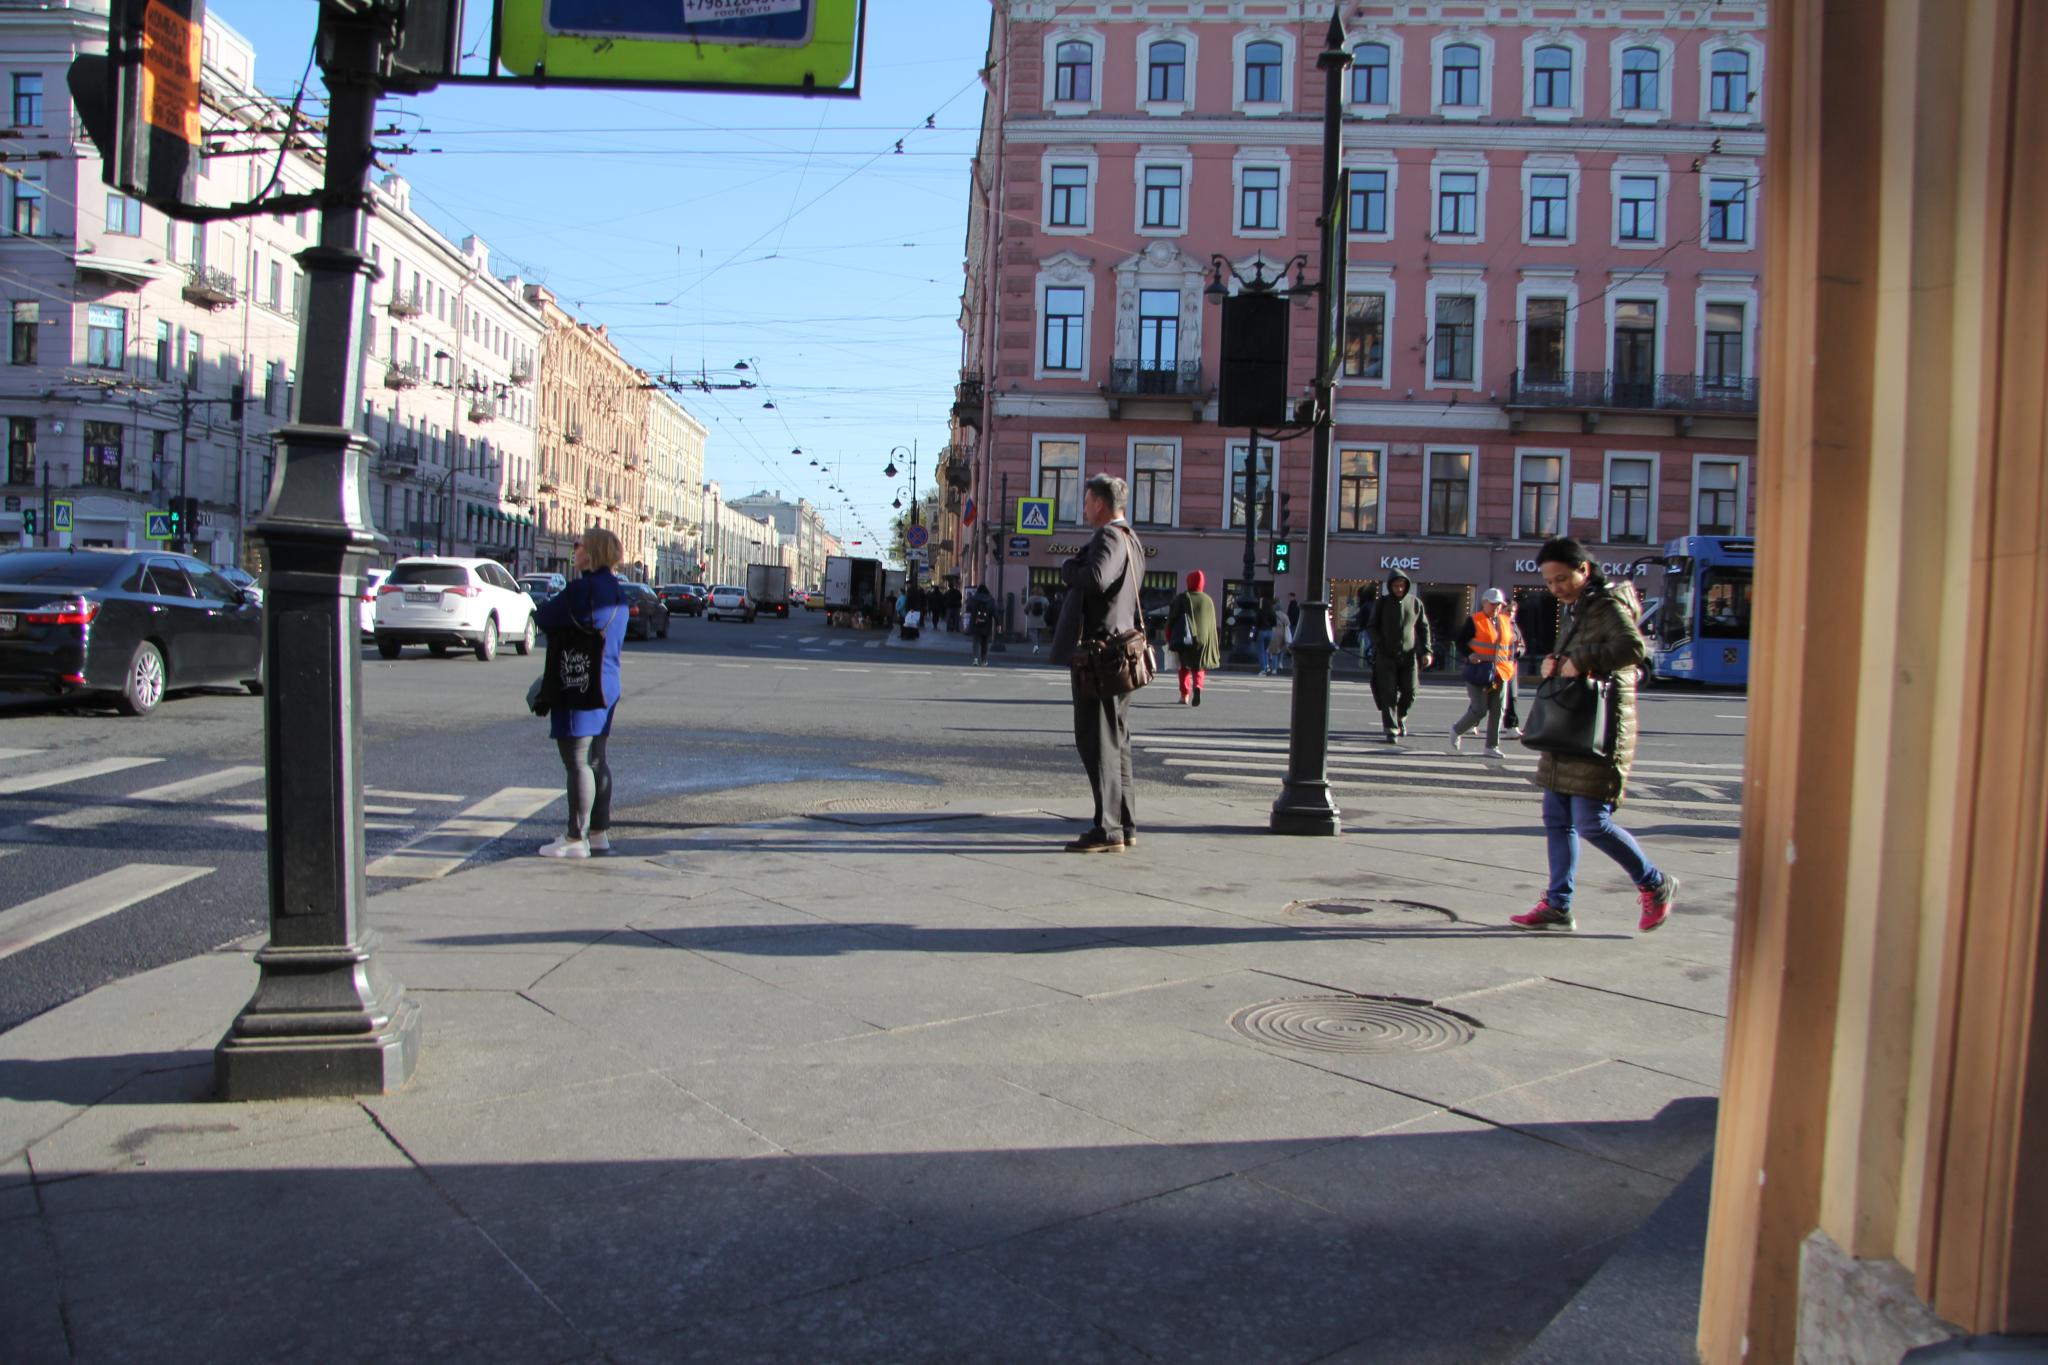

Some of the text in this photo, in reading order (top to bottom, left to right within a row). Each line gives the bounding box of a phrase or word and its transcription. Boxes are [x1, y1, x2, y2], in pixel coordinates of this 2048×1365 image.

[714, 5, 771, 17] roofgo.ru
[1275, 544, 1288, 555] 20
[1380, 556, 1421, 570] КАФЕ
